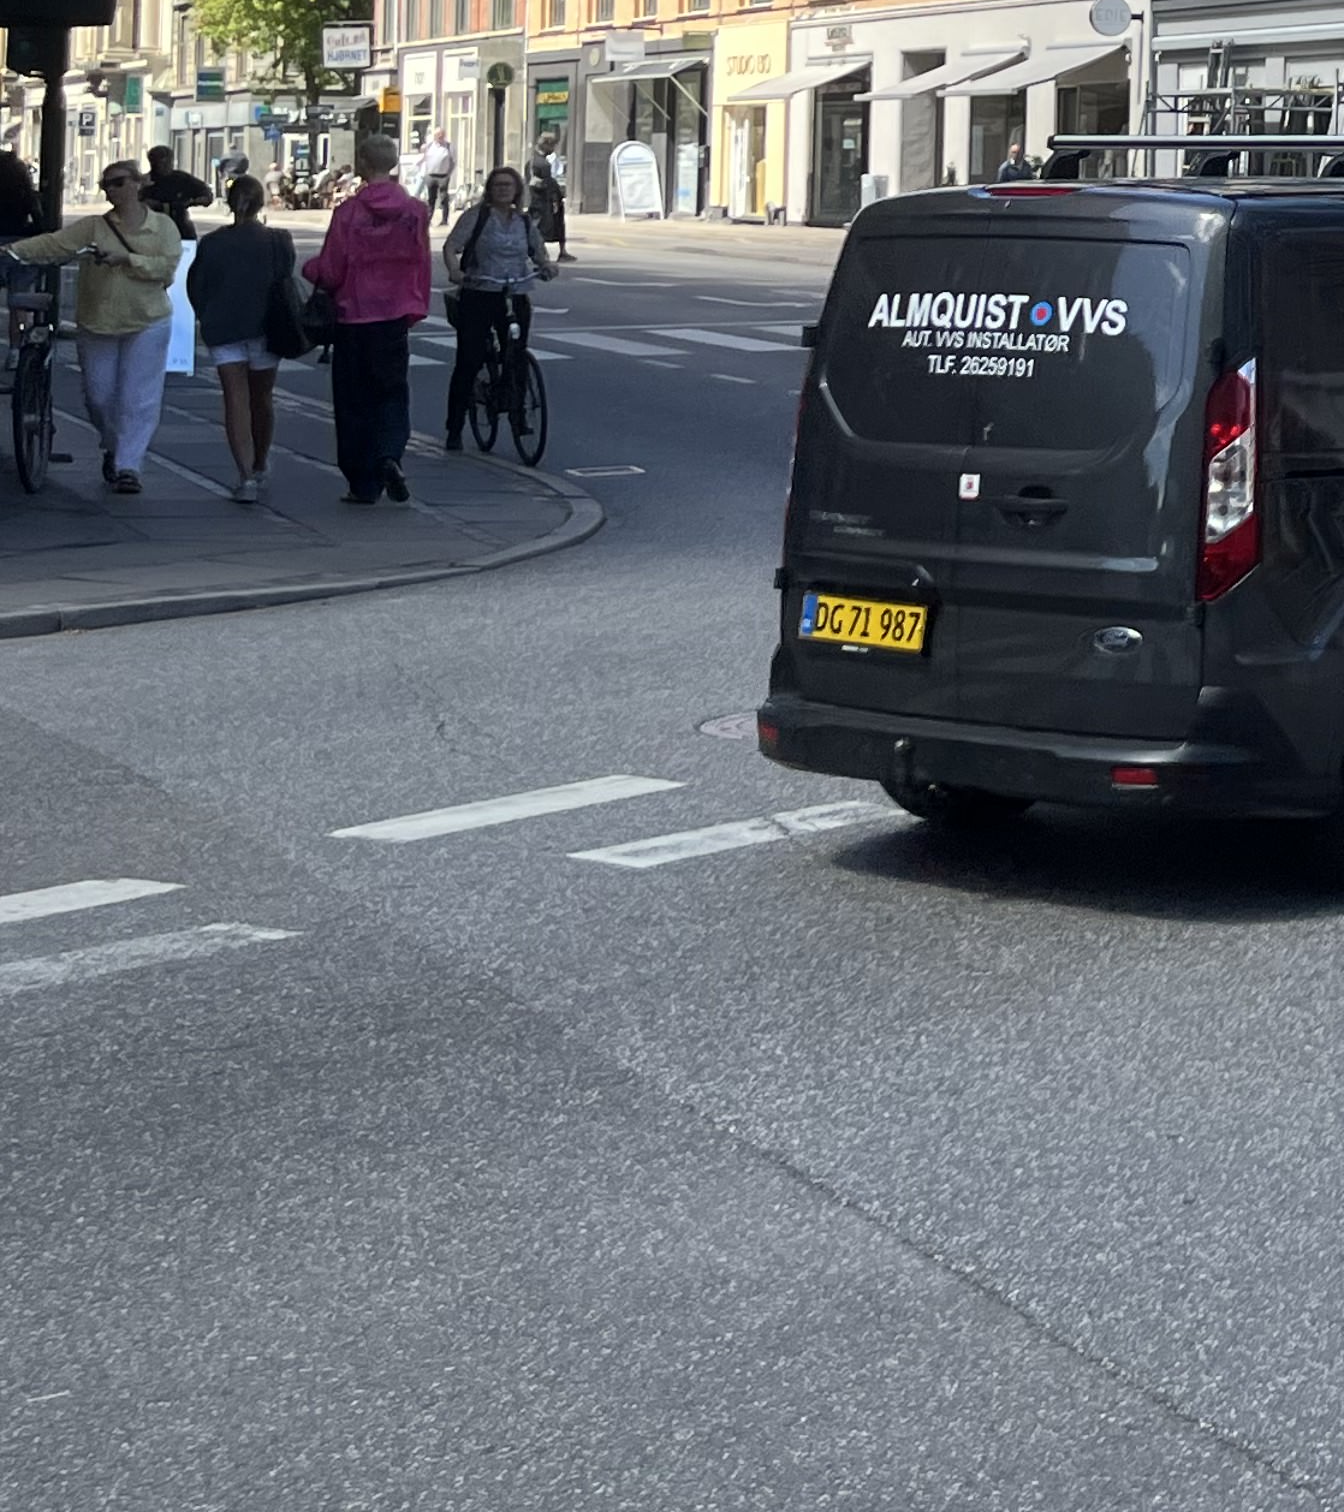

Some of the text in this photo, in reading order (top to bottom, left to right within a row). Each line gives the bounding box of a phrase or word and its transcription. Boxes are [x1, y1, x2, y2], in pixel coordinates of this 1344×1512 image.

[867, 291, 1129, 337] ALMQUIST VVS
[901, 330, 1070, 354] AUT. VVS INSTALLATØR
[926, 354, 1035, 378] TLF. 26259191
[814, 601, 922, 643] DG 71 987
